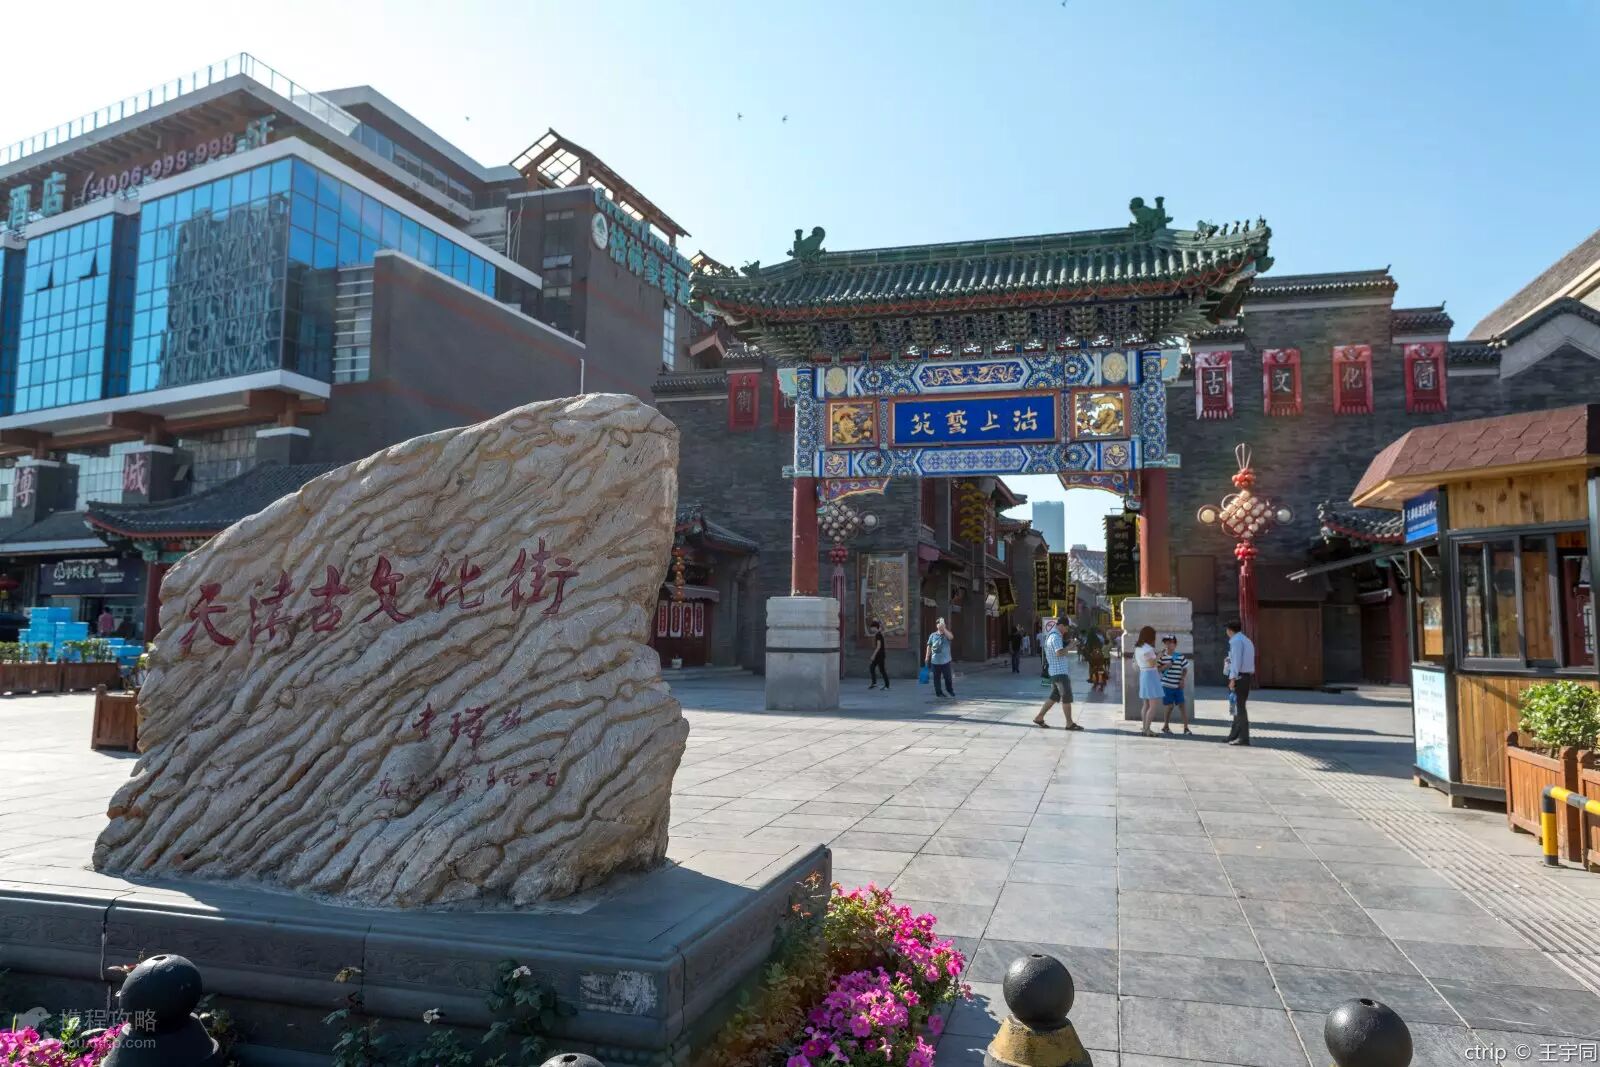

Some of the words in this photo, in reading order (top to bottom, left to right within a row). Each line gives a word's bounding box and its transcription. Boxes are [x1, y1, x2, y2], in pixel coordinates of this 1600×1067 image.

[1205, 368, 1224, 395] 古
[1273, 369, 1292, 393] 文
[1342, 366, 1364, 390] 化
[123, 453, 148, 495] 城
[177, 536, 580, 656] 天津古文化街
